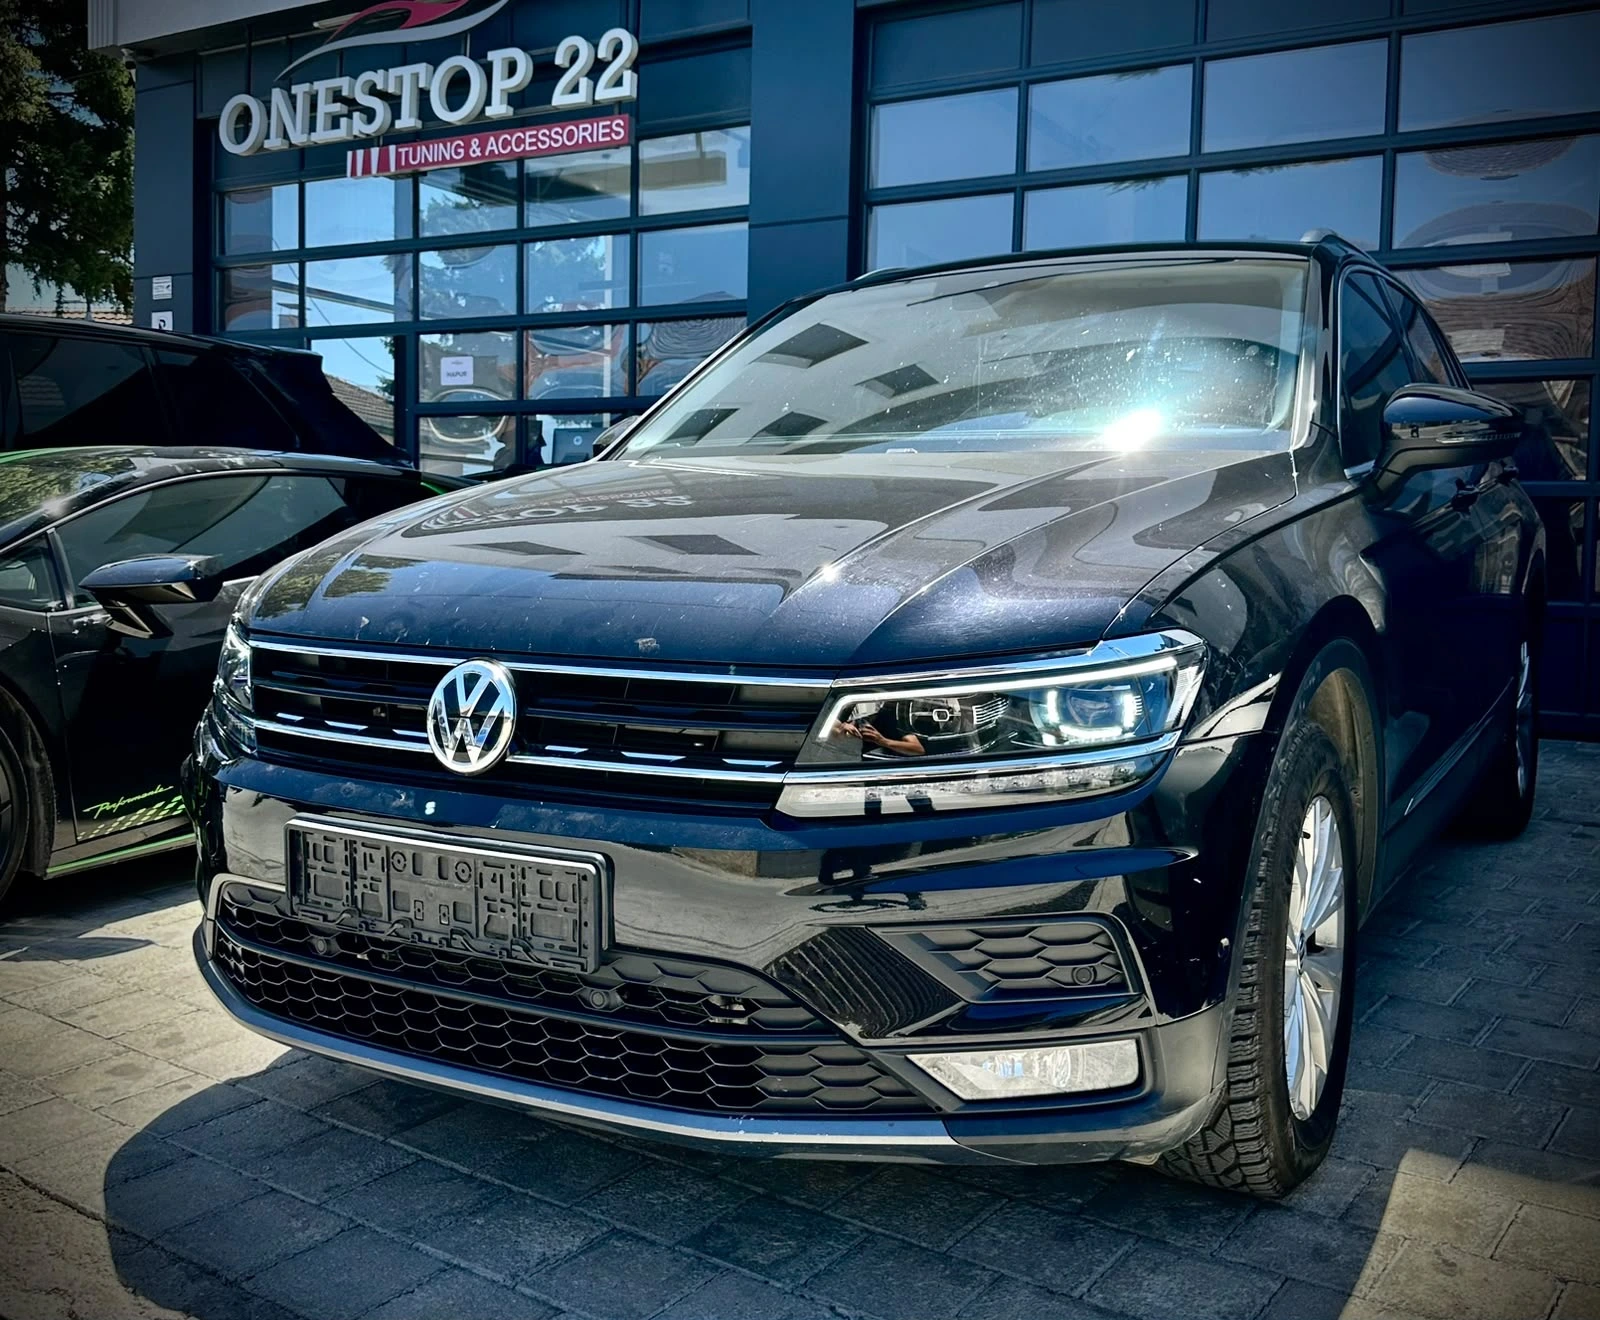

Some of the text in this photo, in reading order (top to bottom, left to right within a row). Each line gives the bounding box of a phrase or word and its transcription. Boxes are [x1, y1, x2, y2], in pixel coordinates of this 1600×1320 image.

[219, 27, 639, 156] ONESTOP 22
[398, 119, 625, 167] TUNING & ACCESSORIES
[429, 660, 516, 773] VW
